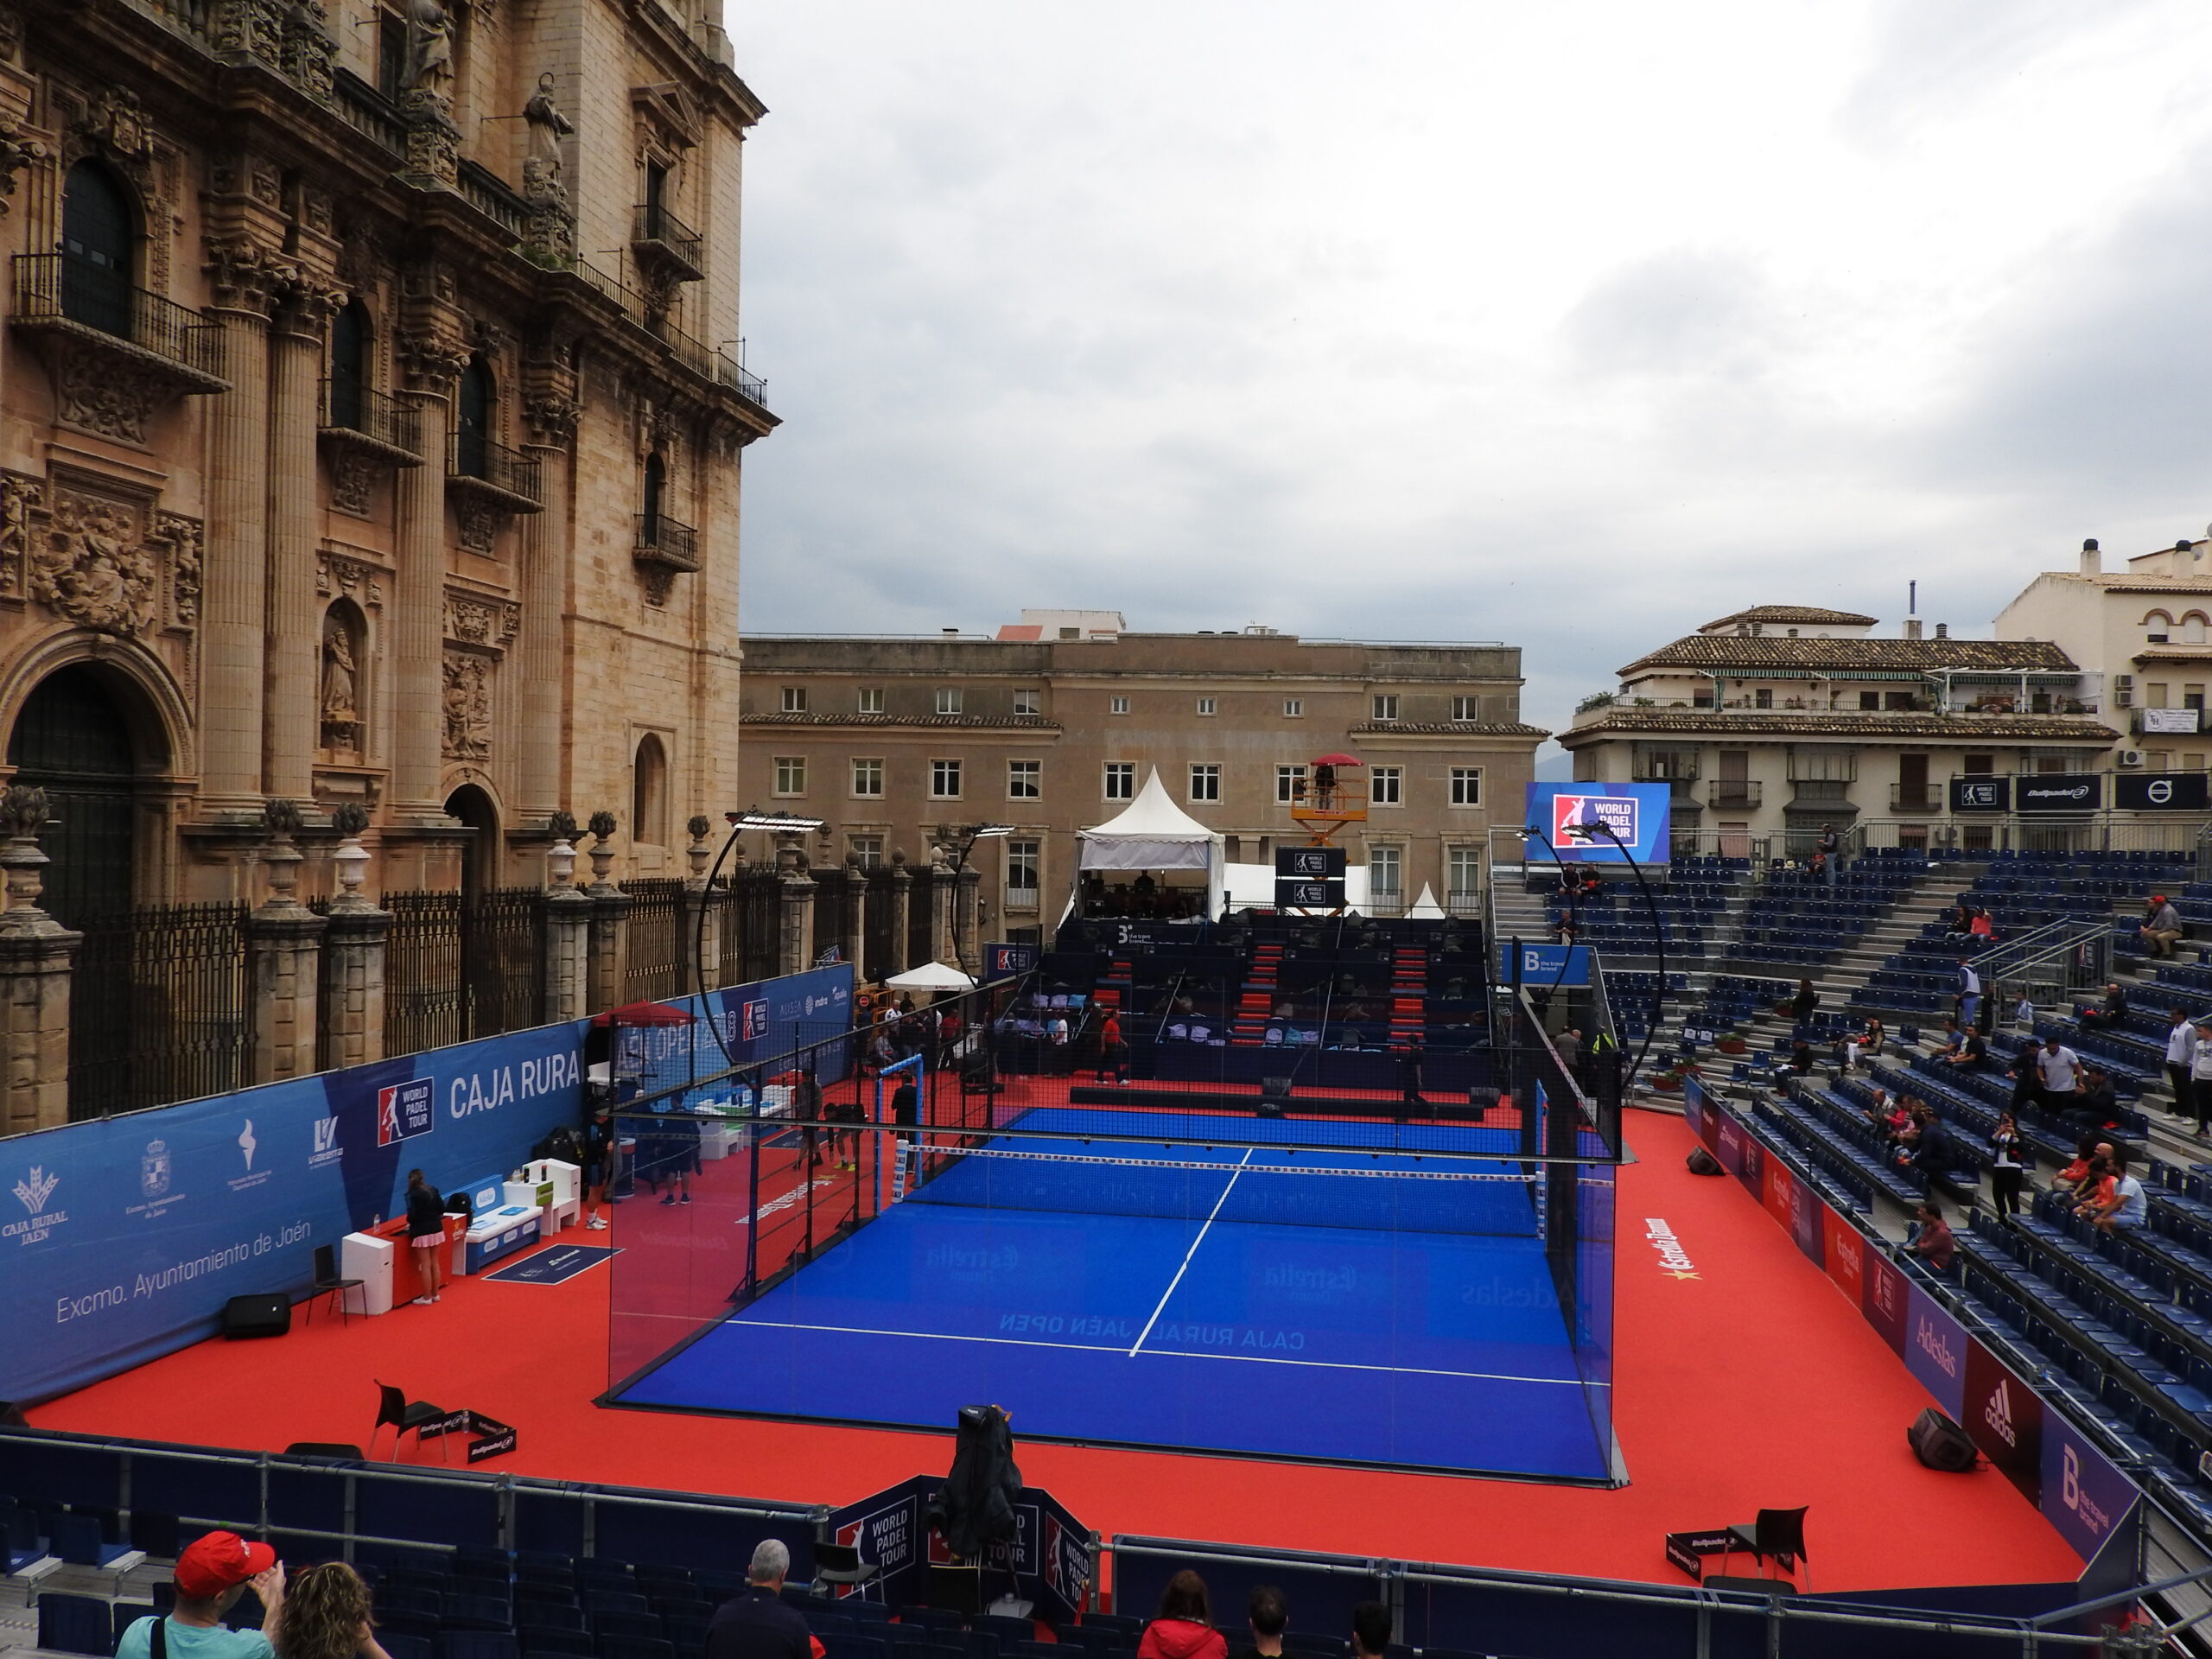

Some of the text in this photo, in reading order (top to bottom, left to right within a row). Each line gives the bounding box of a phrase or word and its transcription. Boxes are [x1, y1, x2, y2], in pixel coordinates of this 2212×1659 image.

[1594, 803, 1631, 815] WORLD
[1524, 950, 1540, 971] B
[402, 1086, 429, 1103] WORLD
[450, 1049, 585, 1119] CAJA RURA
[405, 1100, 429, 1116] PADEL
[408, 1114, 428, 1129] TOUR
[2, 1211, 69, 1237] CAJA RURAL
[21, 1227, 49, 1247] JAÉN
[56, 1220, 311, 1324] Excmo. Ayuntamiento de Jaén
[1916, 1313, 1956, 1378] Adeslas
[1985, 1406, 2016, 1448] adidas
[2063, 1443, 2080, 1510] B
[2079, 1503, 2099, 1535] brand
[2080, 1490, 2109, 1529] the travel
[872, 1509, 908, 1539] WORLD
[875, 1529, 907, 1554] PADEL
[880, 1548, 907, 1567] TOUR
[1065, 1541, 1089, 1575] WORLD
